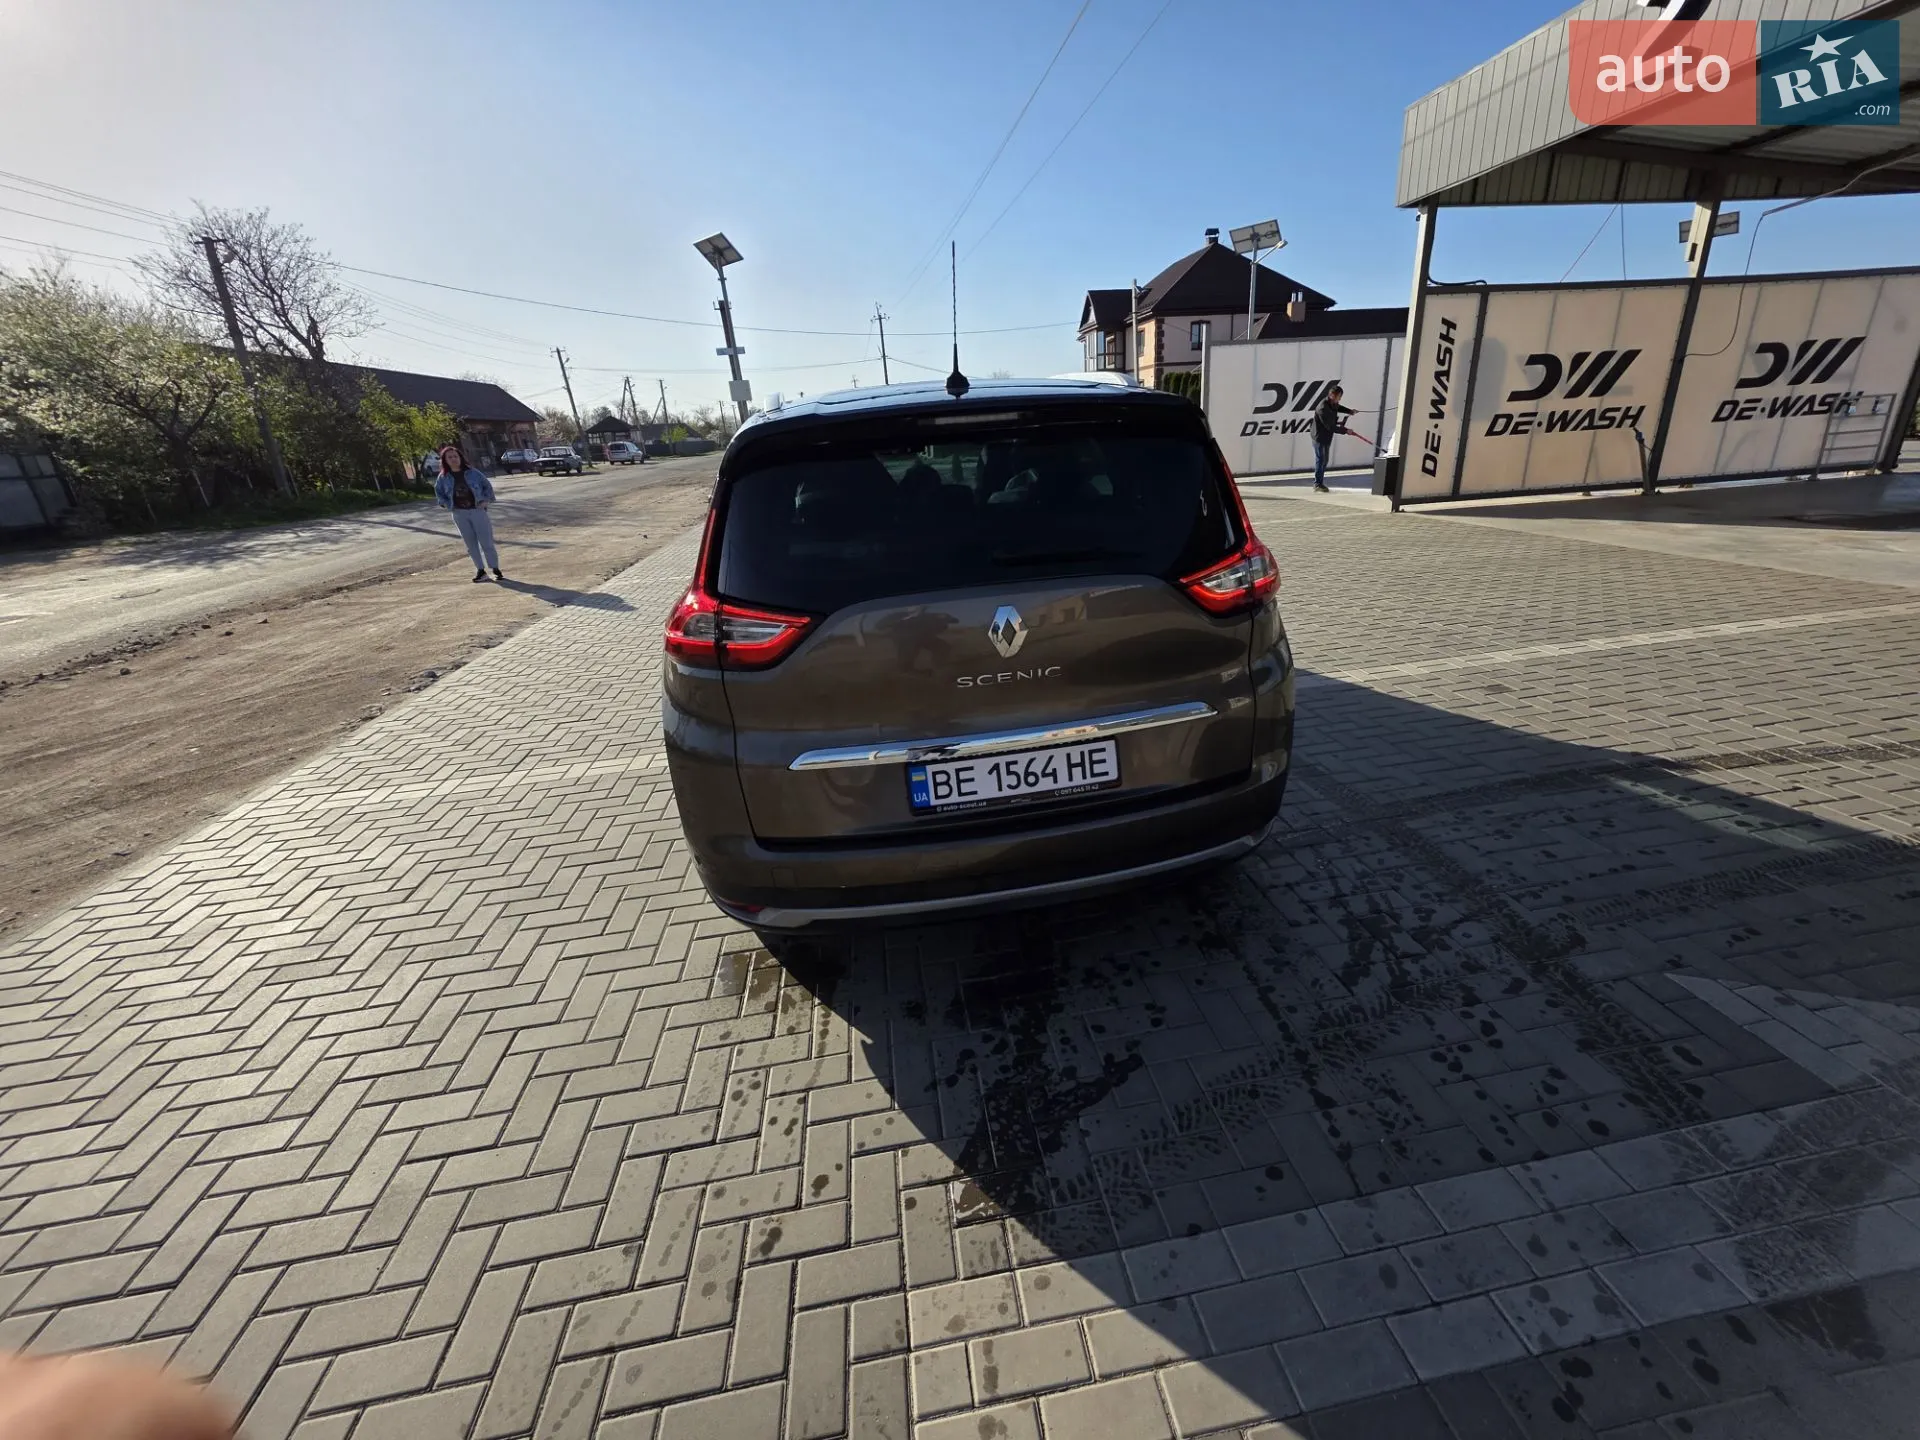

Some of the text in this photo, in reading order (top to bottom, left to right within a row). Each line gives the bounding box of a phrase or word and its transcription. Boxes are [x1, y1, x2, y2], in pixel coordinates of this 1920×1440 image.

[957, 666, 1062, 688] SCENIC
[932, 747, 1110, 800] BE 1564 HE
[914, 793, 929, 803] UA
